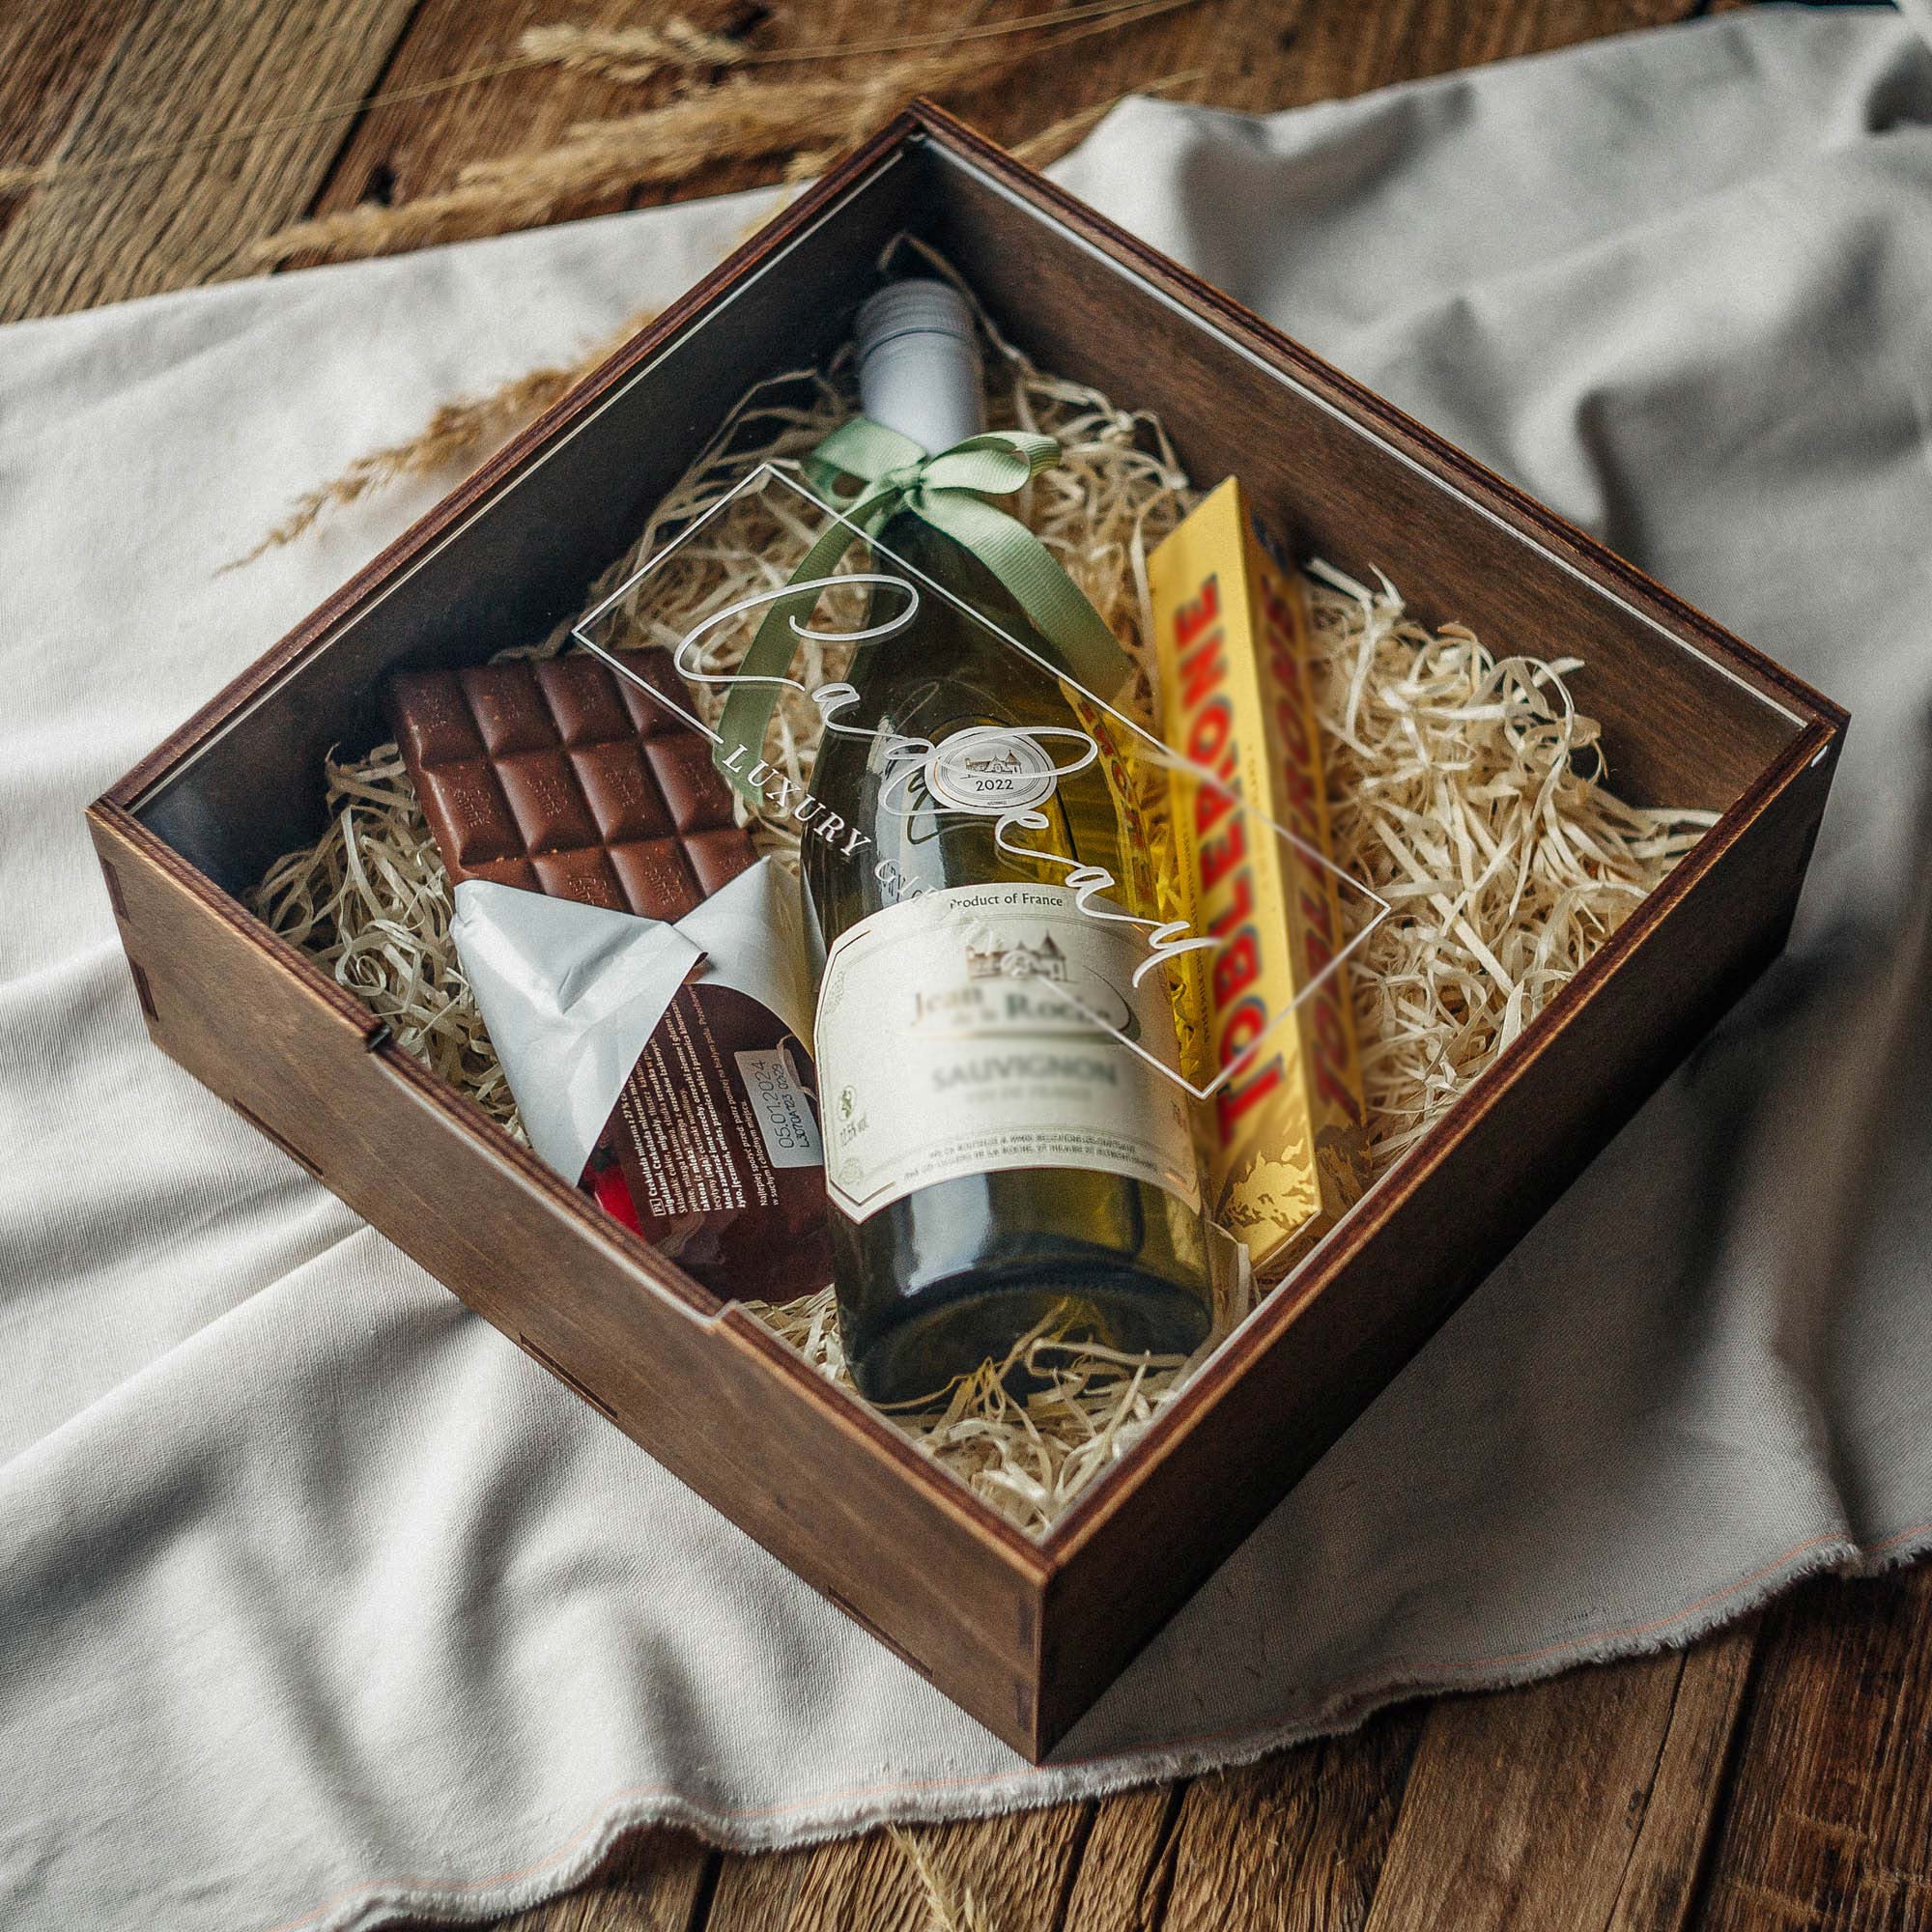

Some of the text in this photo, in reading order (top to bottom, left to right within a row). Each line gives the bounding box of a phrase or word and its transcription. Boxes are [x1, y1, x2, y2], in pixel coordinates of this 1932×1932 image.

[723, 744, 871, 857] LUXURY
[976, 779, 1014, 792] 2022
[1175, 573, 1285, 1150] TOBLERONE
[1004, 893, 1018, 904] of
[1022, 893, 1063, 906] France
[665, 1018, 681, 1042] gluten
[676, 1046, 691, 1072] ziemne
[683, 1035, 701, 1066] pszenica
[648, 1068, 665, 1101] serwatka
[664, 1077, 680, 1112] orzechów
[683, 1073, 700, 1103] orzeszki
[696, 1071, 709, 1094] orkisz
[633, 1095, 649, 1130] mleczna:
[696, 1103, 711, 1136] orzechy,
[704, 1094, 722, 1126] pszenica
[752, 1060, 794, 1149] 05.01.2024
[630, 1124, 645, 1156] mleczna
[643, 1130, 662, 1170] Czekolada
[690, 1125, 706, 1154] ekstrakt
[706, 1136, 718, 1153] inne
[716, 1126, 728, 1151] owies,
[639, 1157, 658, 1197] Czekolada
[710, 1154, 728, 1187] zawierać
[764, 1169, 778, 1198] suchym
[655, 1170, 675, 1214] migdałami.
[708, 1179, 723, 1210] lecytyny
[722, 1188, 734, 1209] Może
